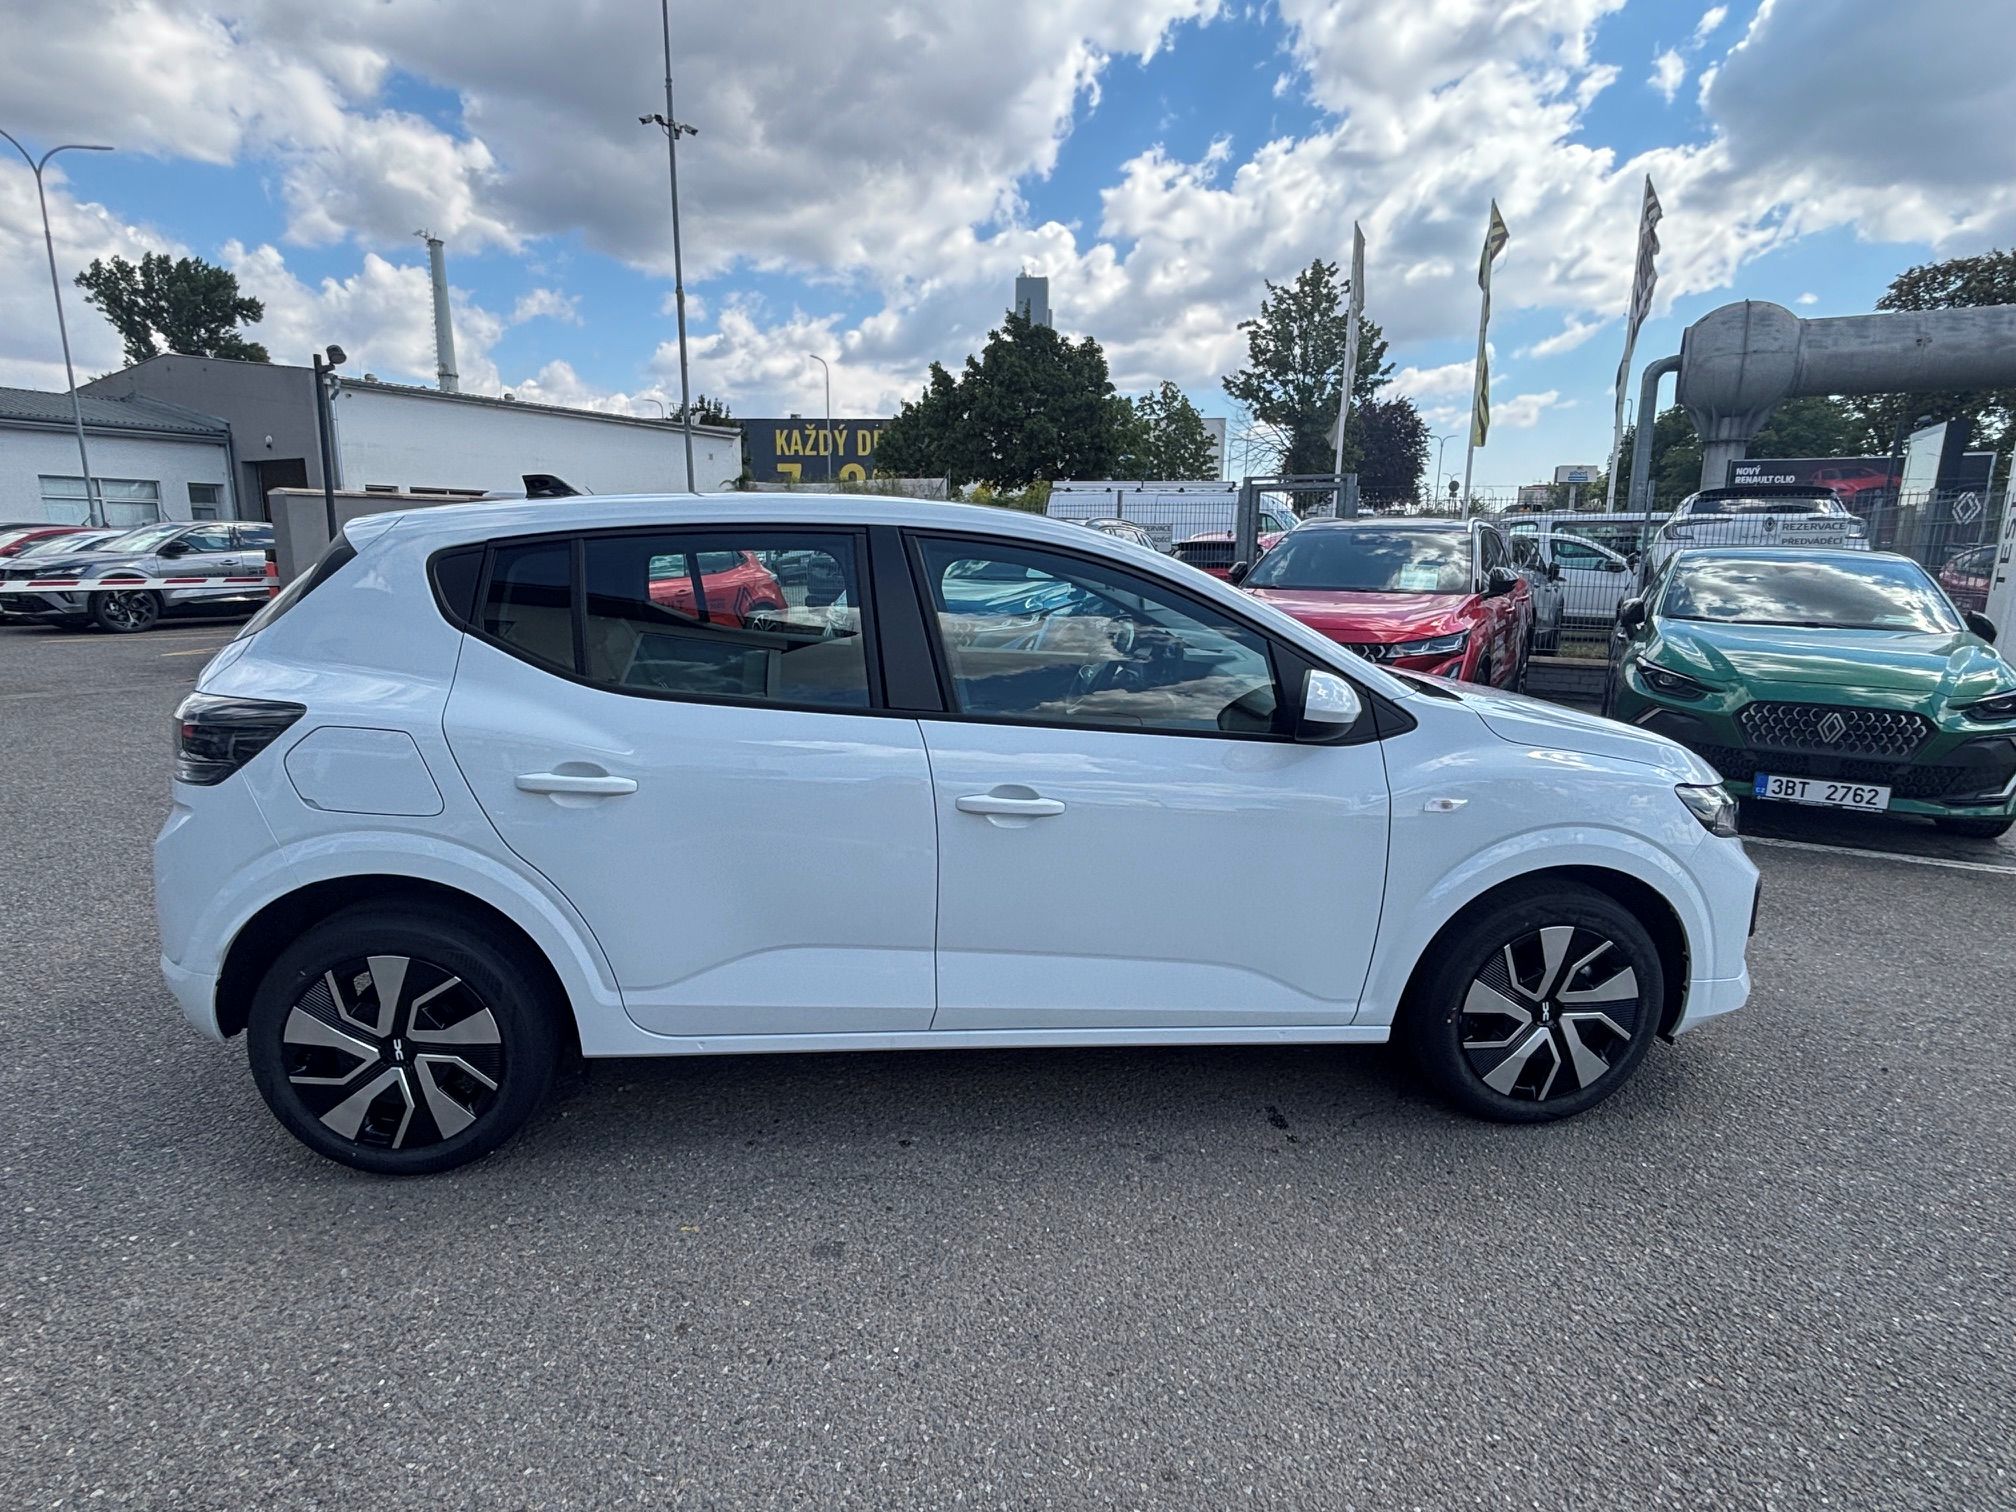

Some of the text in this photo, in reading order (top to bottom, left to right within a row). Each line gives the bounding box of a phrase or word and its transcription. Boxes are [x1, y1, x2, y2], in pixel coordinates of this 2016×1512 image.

[775, 423, 848, 456] KAŽDÝ
[1736, 465, 1761, 475] NOVÝ
[1735, 475, 1796, 484] RENAULT CLIO
[1782, 522, 1847, 531] REZERVACE
[1755, 786, 1766, 794] CZ
[1771, 779, 1810, 798] 3BT
[1825, 784, 1879, 805] 2762
